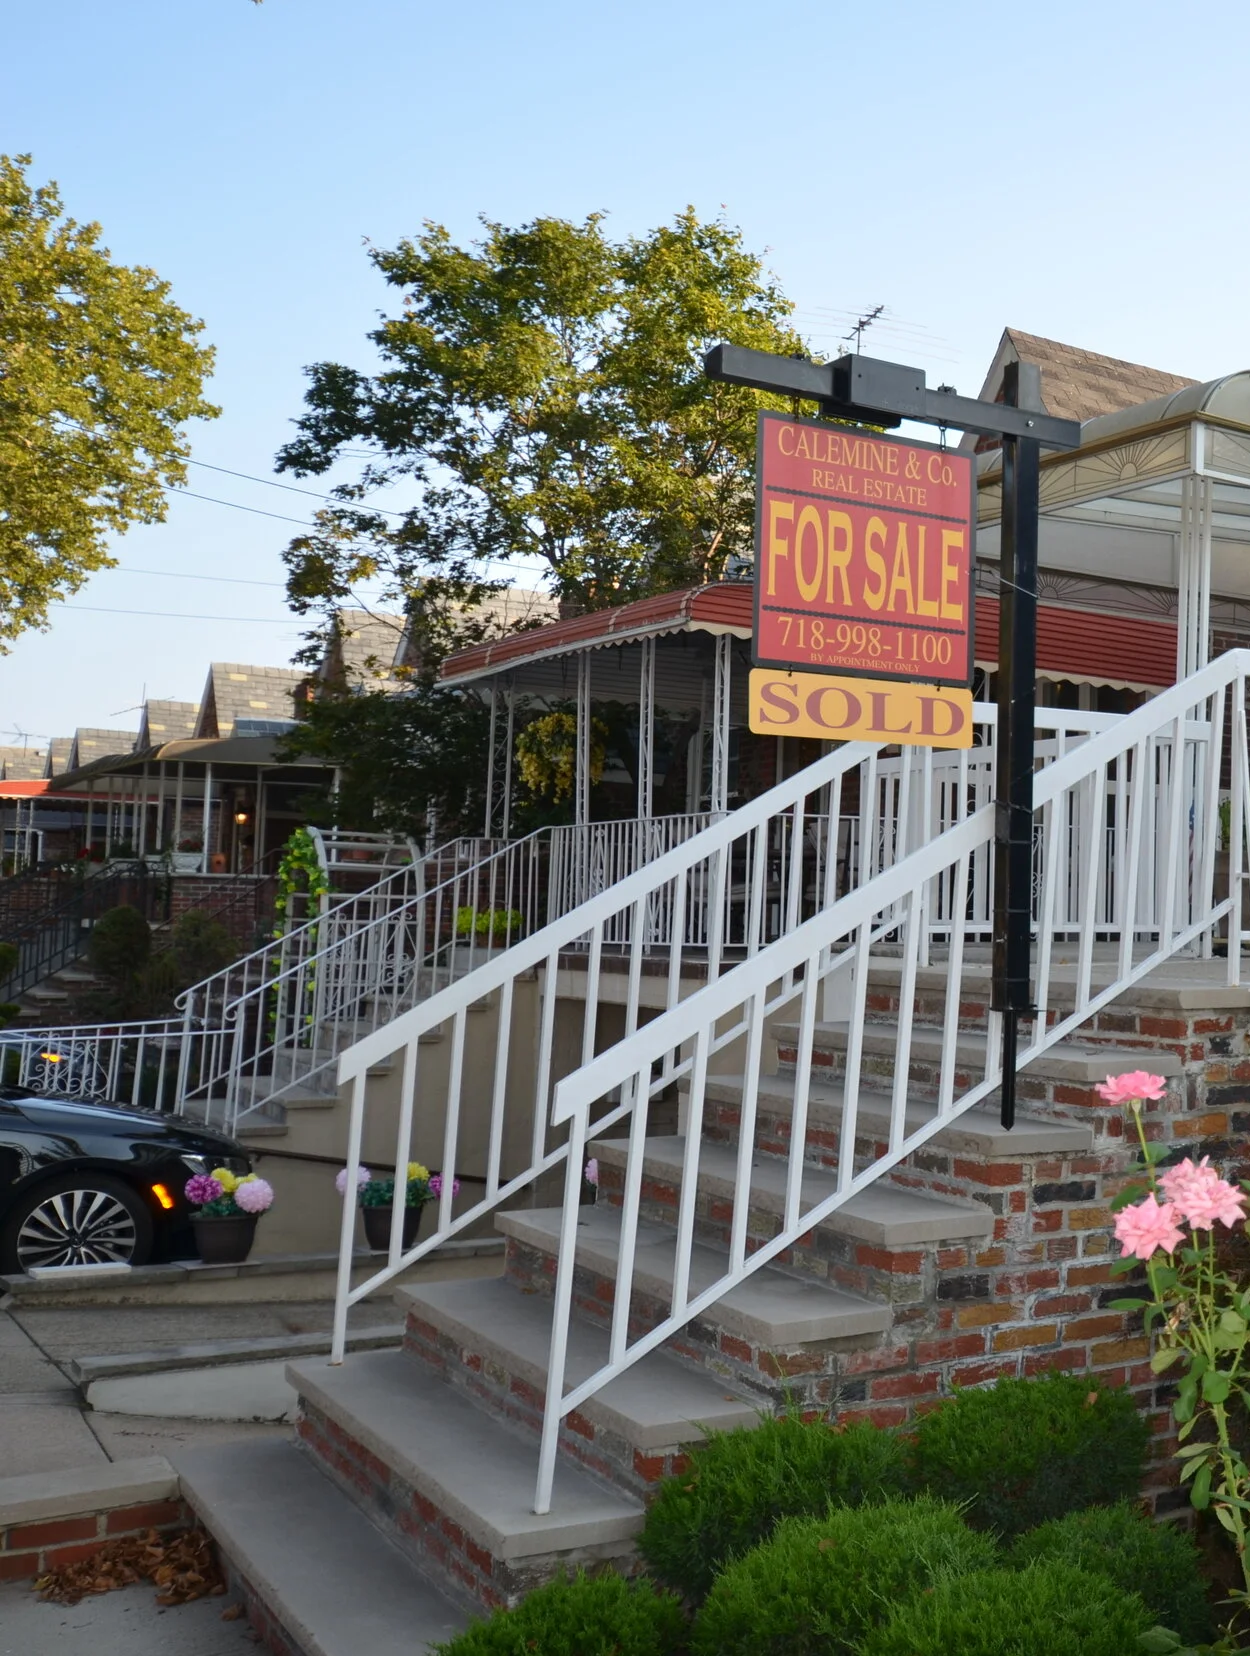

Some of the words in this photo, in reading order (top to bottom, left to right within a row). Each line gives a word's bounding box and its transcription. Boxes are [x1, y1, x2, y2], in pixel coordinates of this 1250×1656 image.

[778, 426, 899, 476] CALEMINE
[904, 451, 922, 480] &
[811, 468, 859, 496] REAL
[863, 478, 928, 506] ESTATE
[767, 499, 853, 606] FOR
[863, 516, 964, 624] SALE
[777, 616, 952, 665] 718-998-1100
[810, 652, 824, 662] BY
[827, 655, 893, 670] APPOINTMENT
[894, 661, 921, 673] ONLY
[759, 682, 965, 737] SOLD
